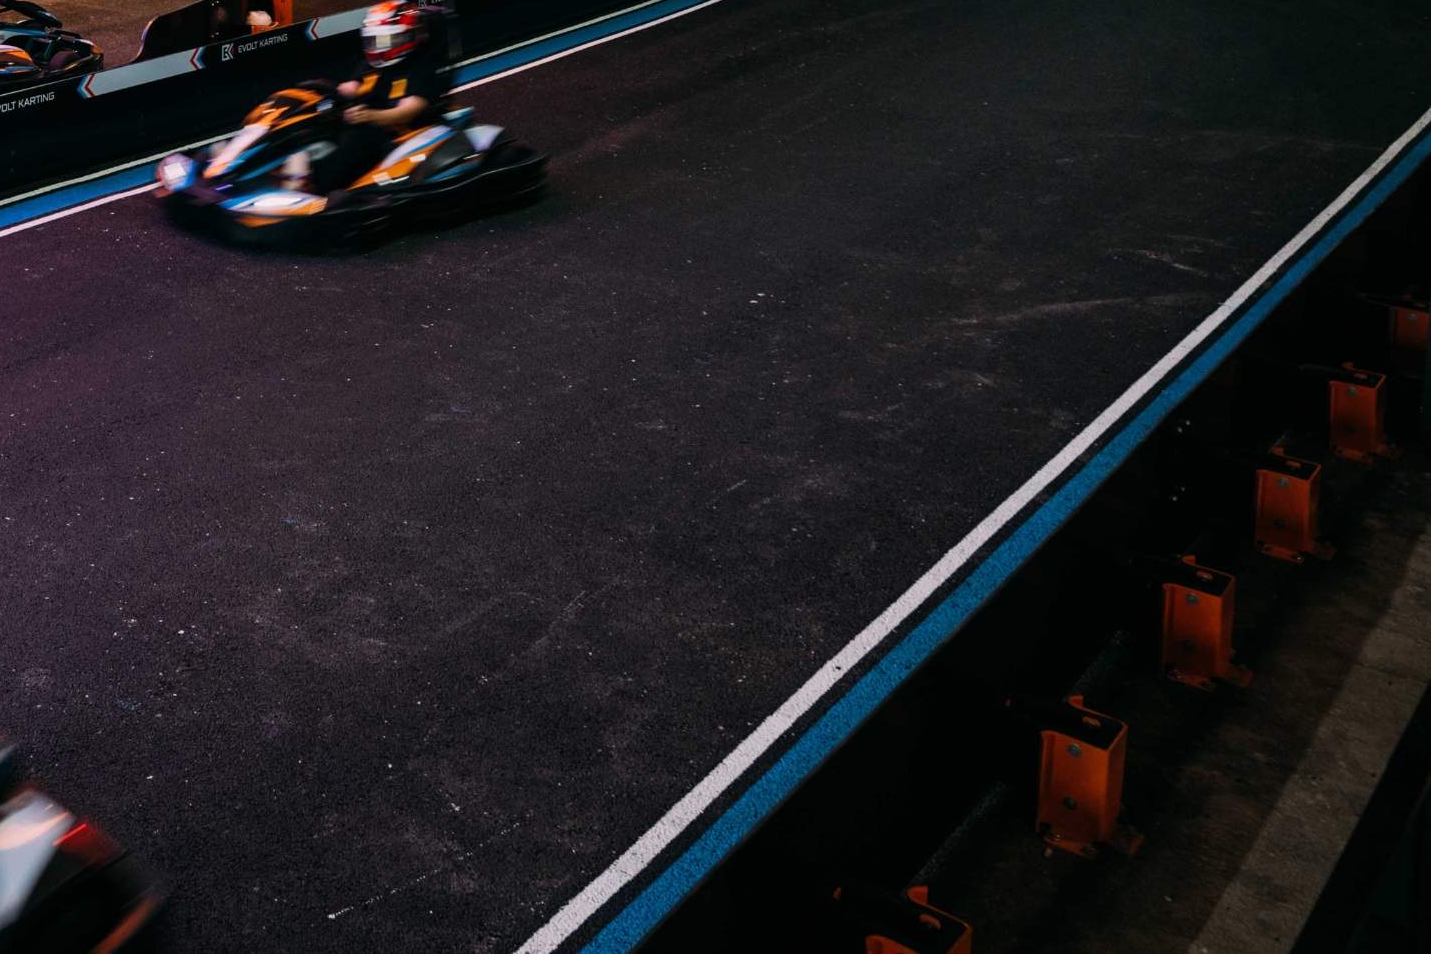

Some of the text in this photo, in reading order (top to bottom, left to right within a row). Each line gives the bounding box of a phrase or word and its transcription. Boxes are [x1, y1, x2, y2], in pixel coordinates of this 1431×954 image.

[238, 41, 259, 54] EVOLT
[258, 33, 289, 49] KARTING
[17, 91, 56, 110] KARTING
